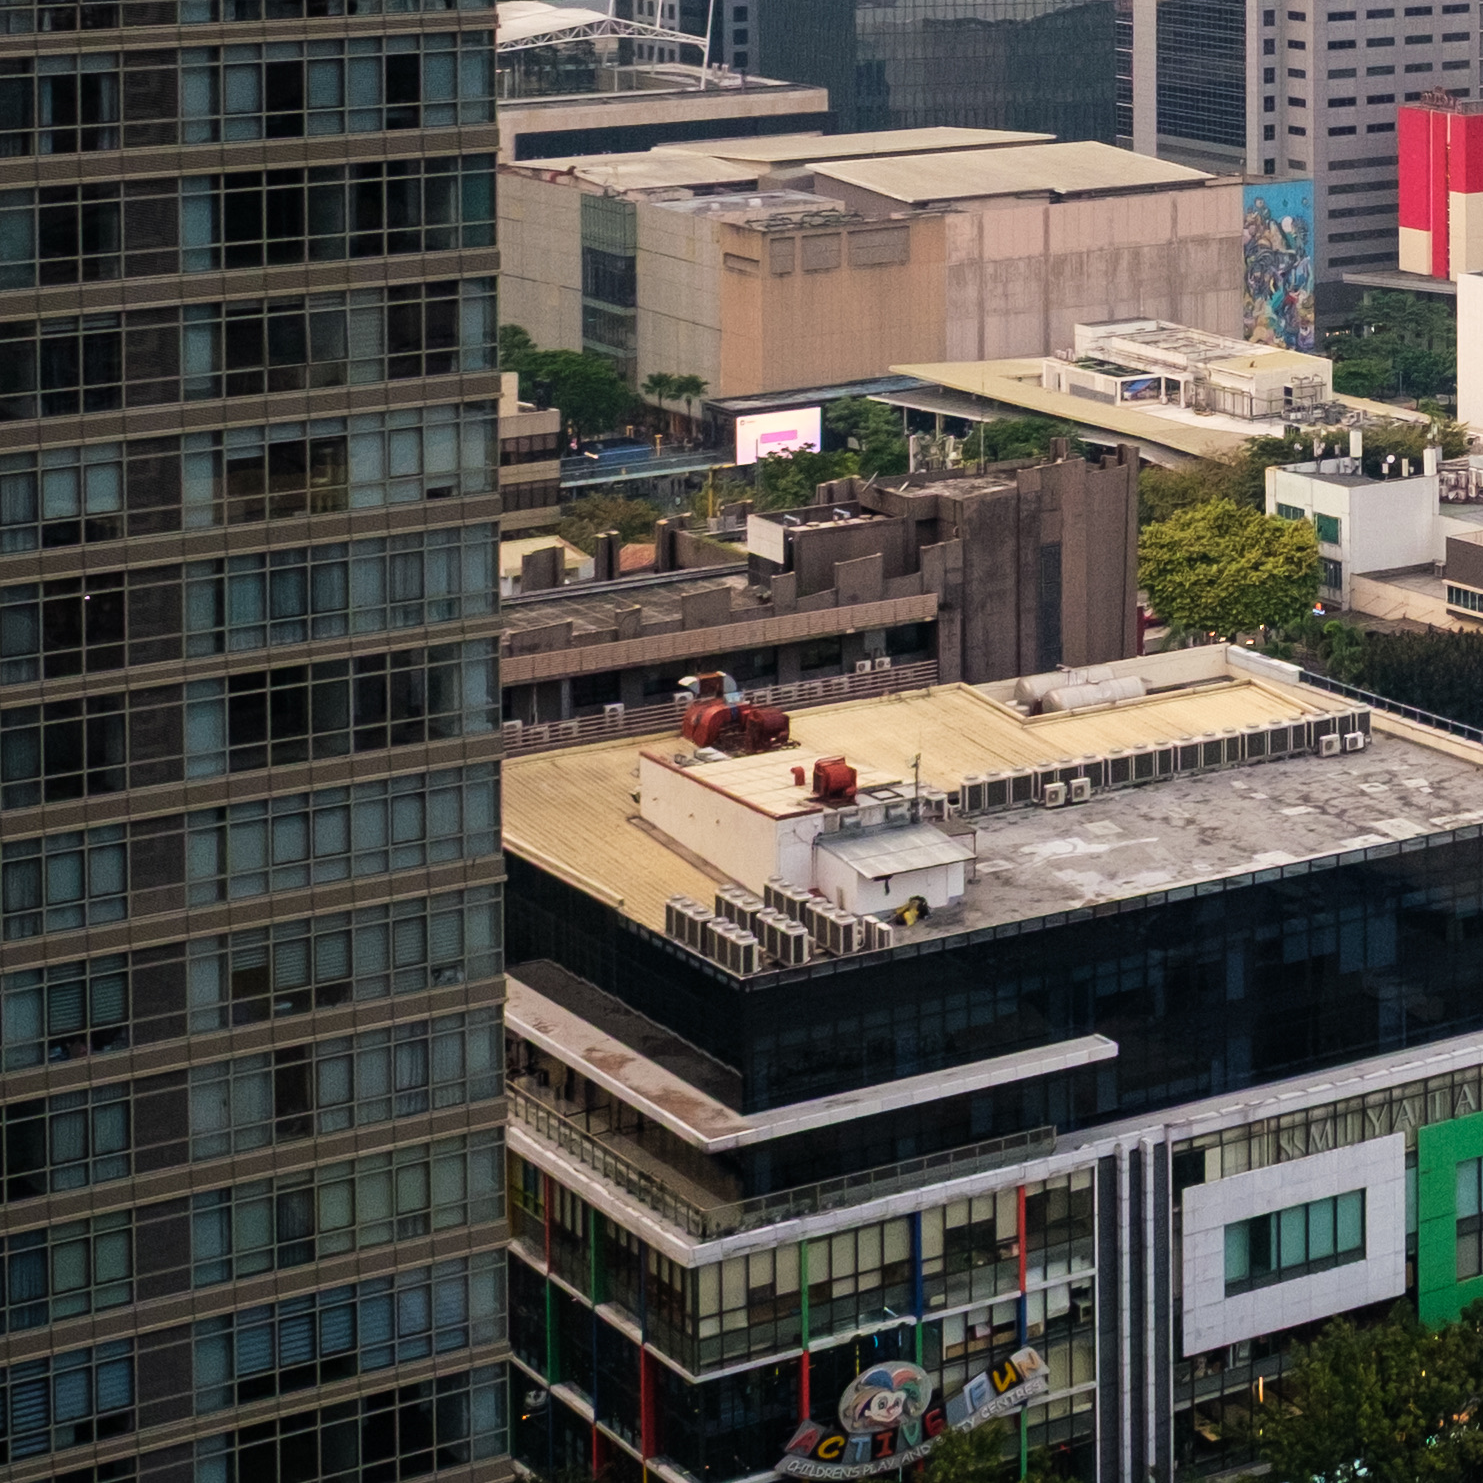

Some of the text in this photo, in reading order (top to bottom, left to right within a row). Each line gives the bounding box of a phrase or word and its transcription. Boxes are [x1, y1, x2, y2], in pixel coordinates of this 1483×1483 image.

[786, 1352, 1039, 1462] ACTIVE FUN
[862, 1459, 895, 1476] PLAY
[901, 1444, 931, 1463] AND
[981, 1381, 1042, 1419] CENTRES
